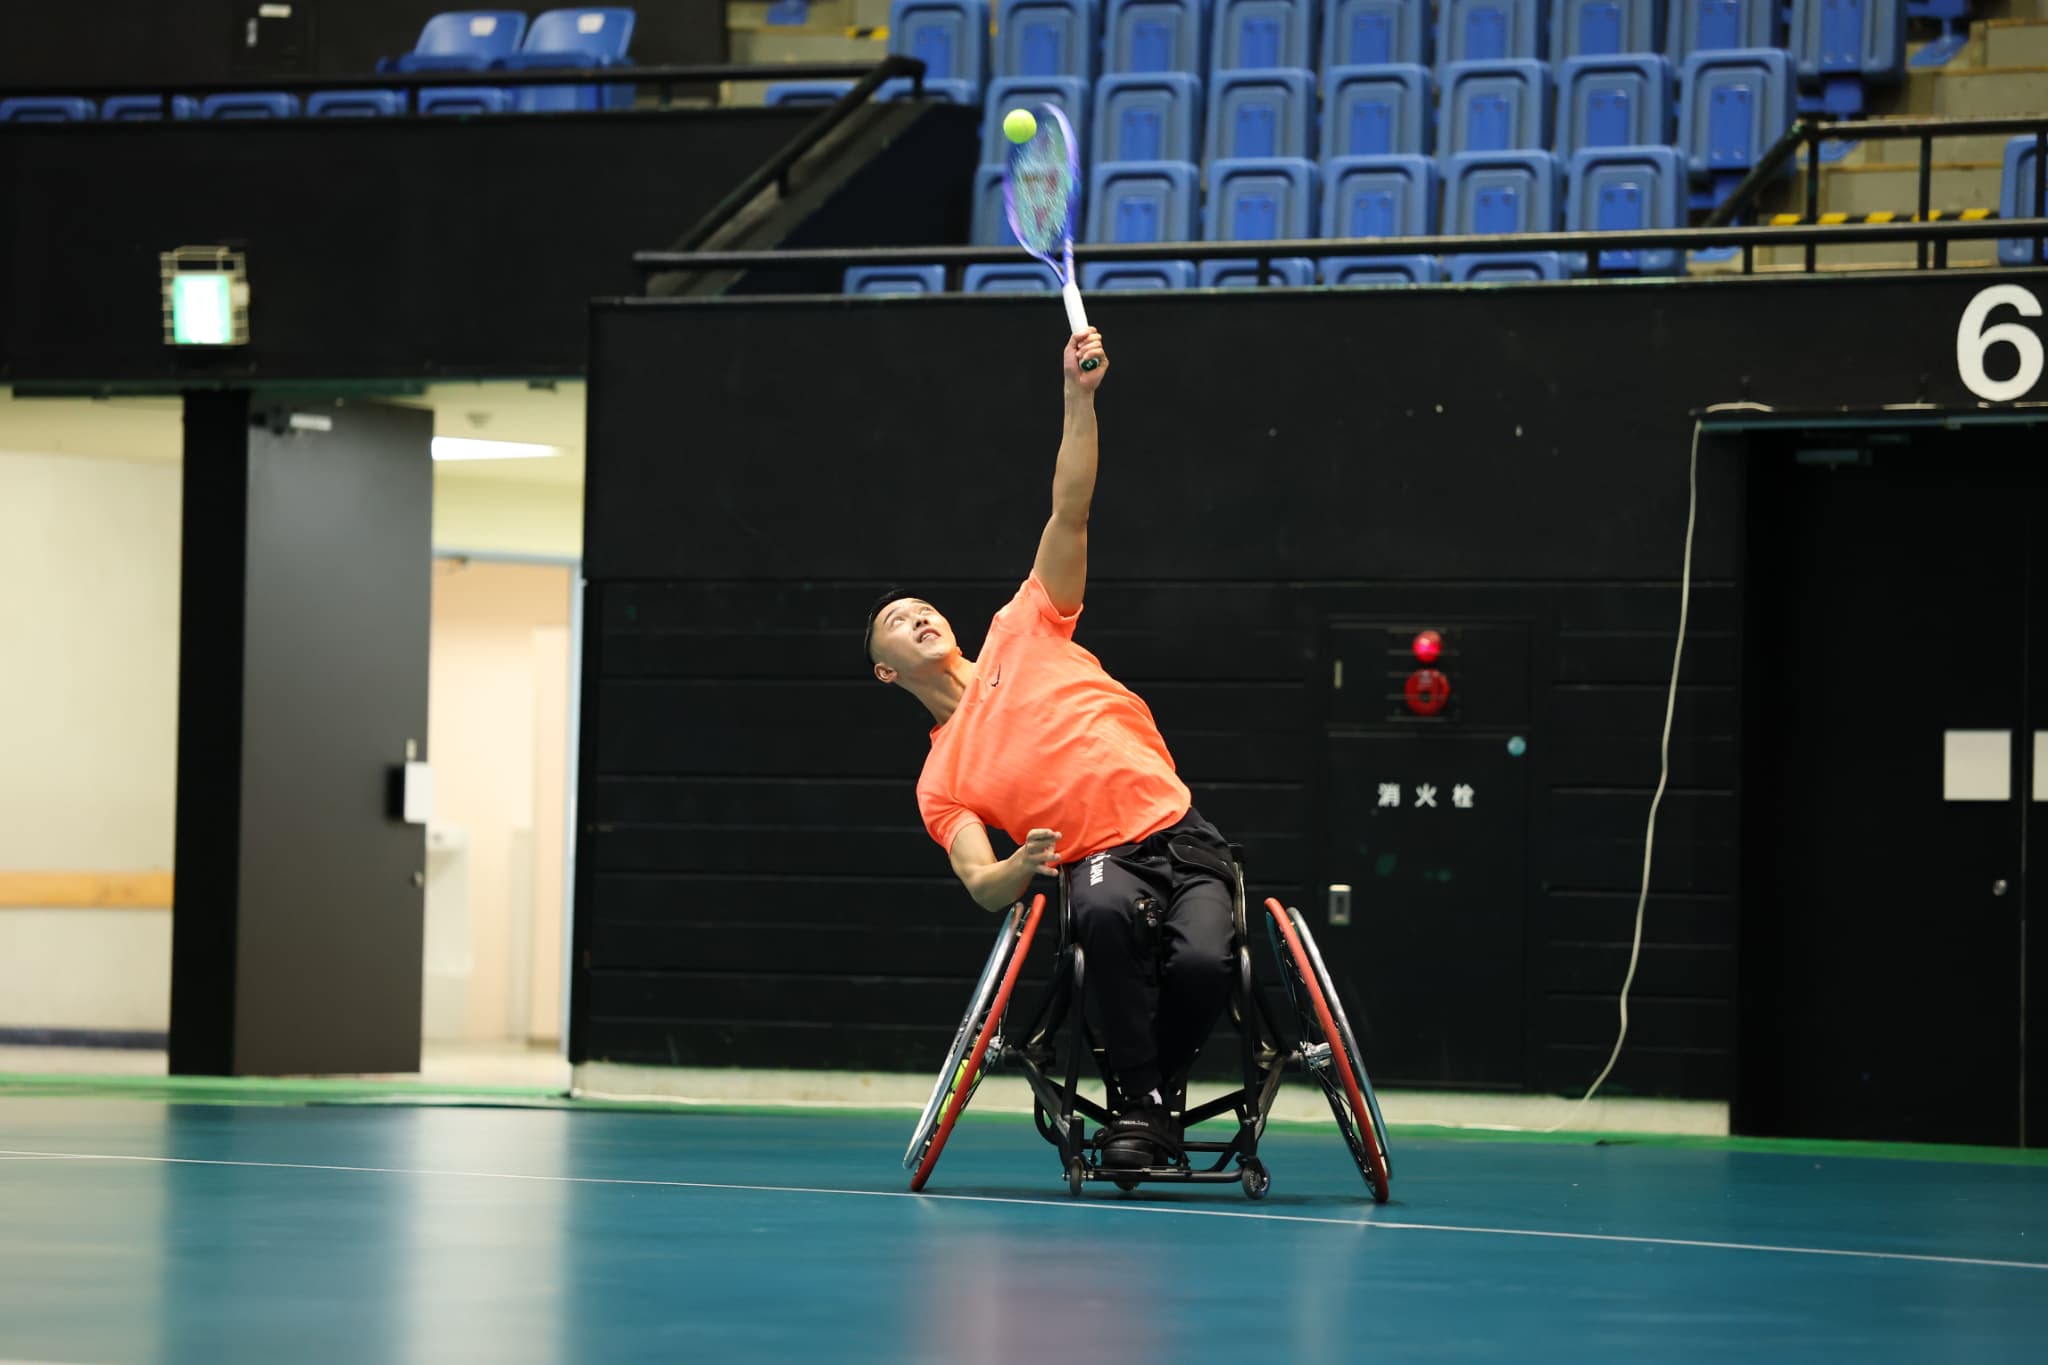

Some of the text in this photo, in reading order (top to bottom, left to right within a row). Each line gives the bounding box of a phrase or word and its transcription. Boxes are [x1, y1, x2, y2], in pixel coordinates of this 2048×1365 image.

[1957, 283, 2045, 401] 6
[1378, 782, 1474, 808] 消火栓
